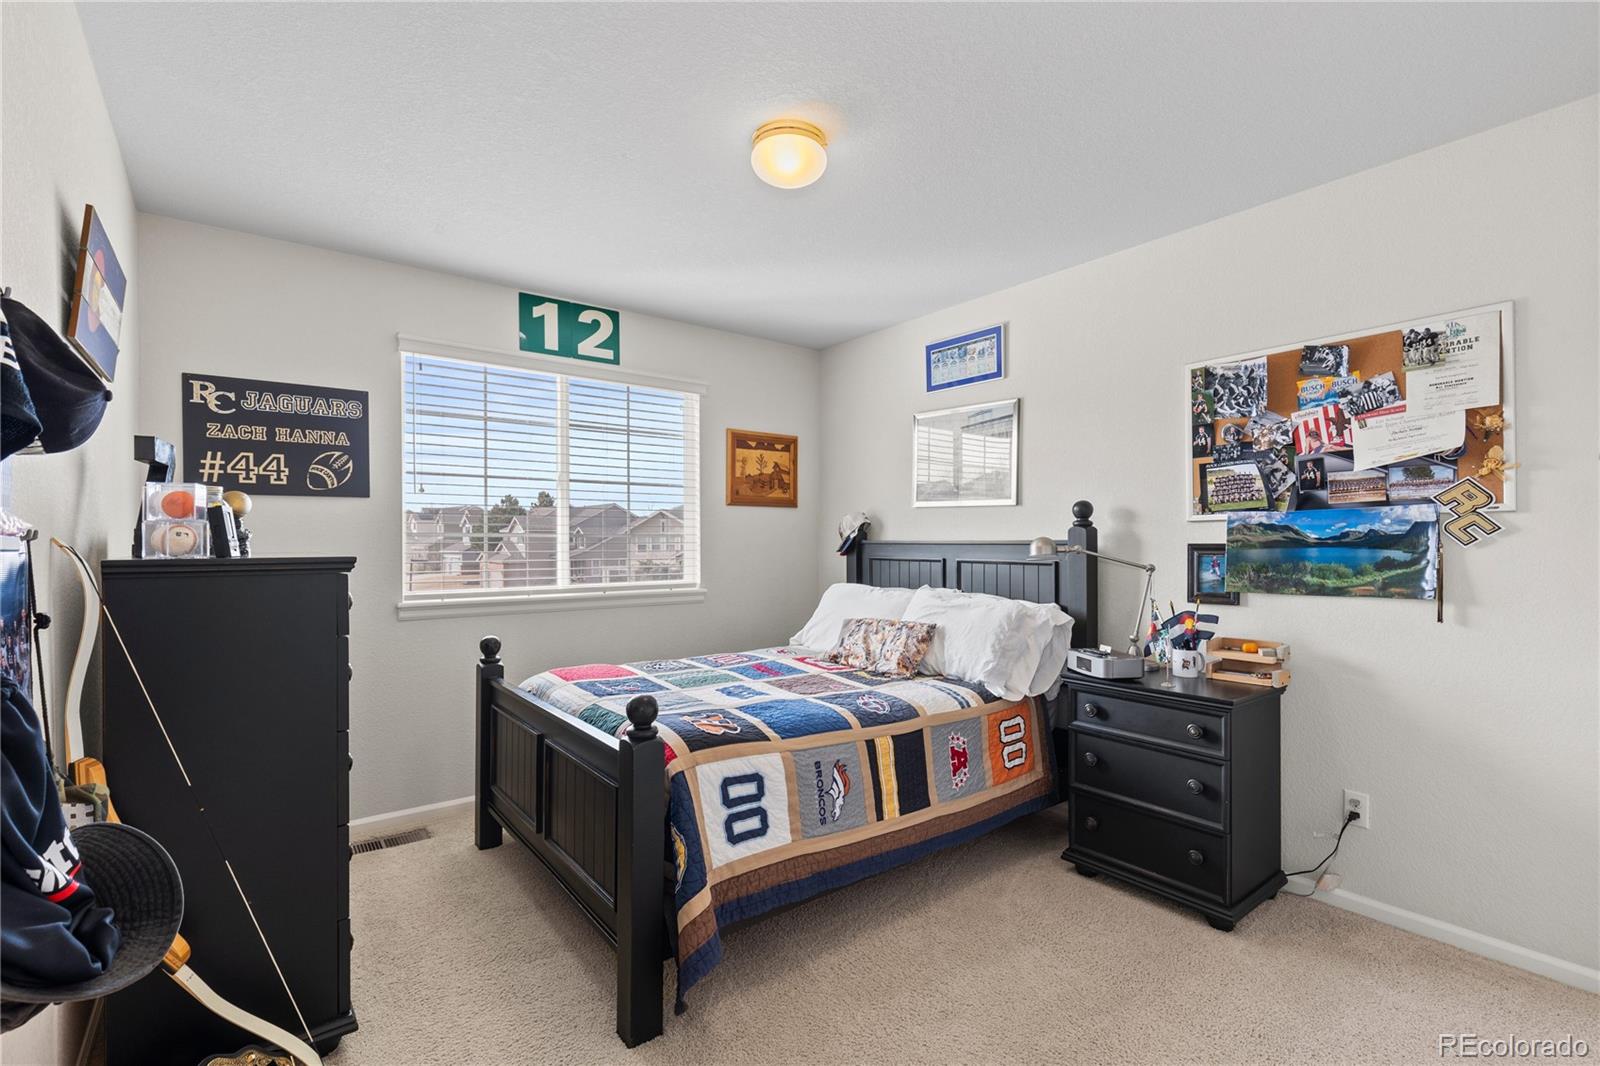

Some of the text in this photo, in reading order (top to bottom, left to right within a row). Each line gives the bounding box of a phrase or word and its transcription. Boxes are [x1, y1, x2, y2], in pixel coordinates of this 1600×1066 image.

[189, 379, 363, 419] RC JAGUARS
[1301, 383, 1325, 393] BUSCH
[1332, 378, 1358, 388] BUSCH
[206, 422, 350, 446] ZACH HANNA
[199, 451, 289, 485] #44
[1432, 477, 1503, 547] RC
[814, 760, 827, 826] BRONCOS
